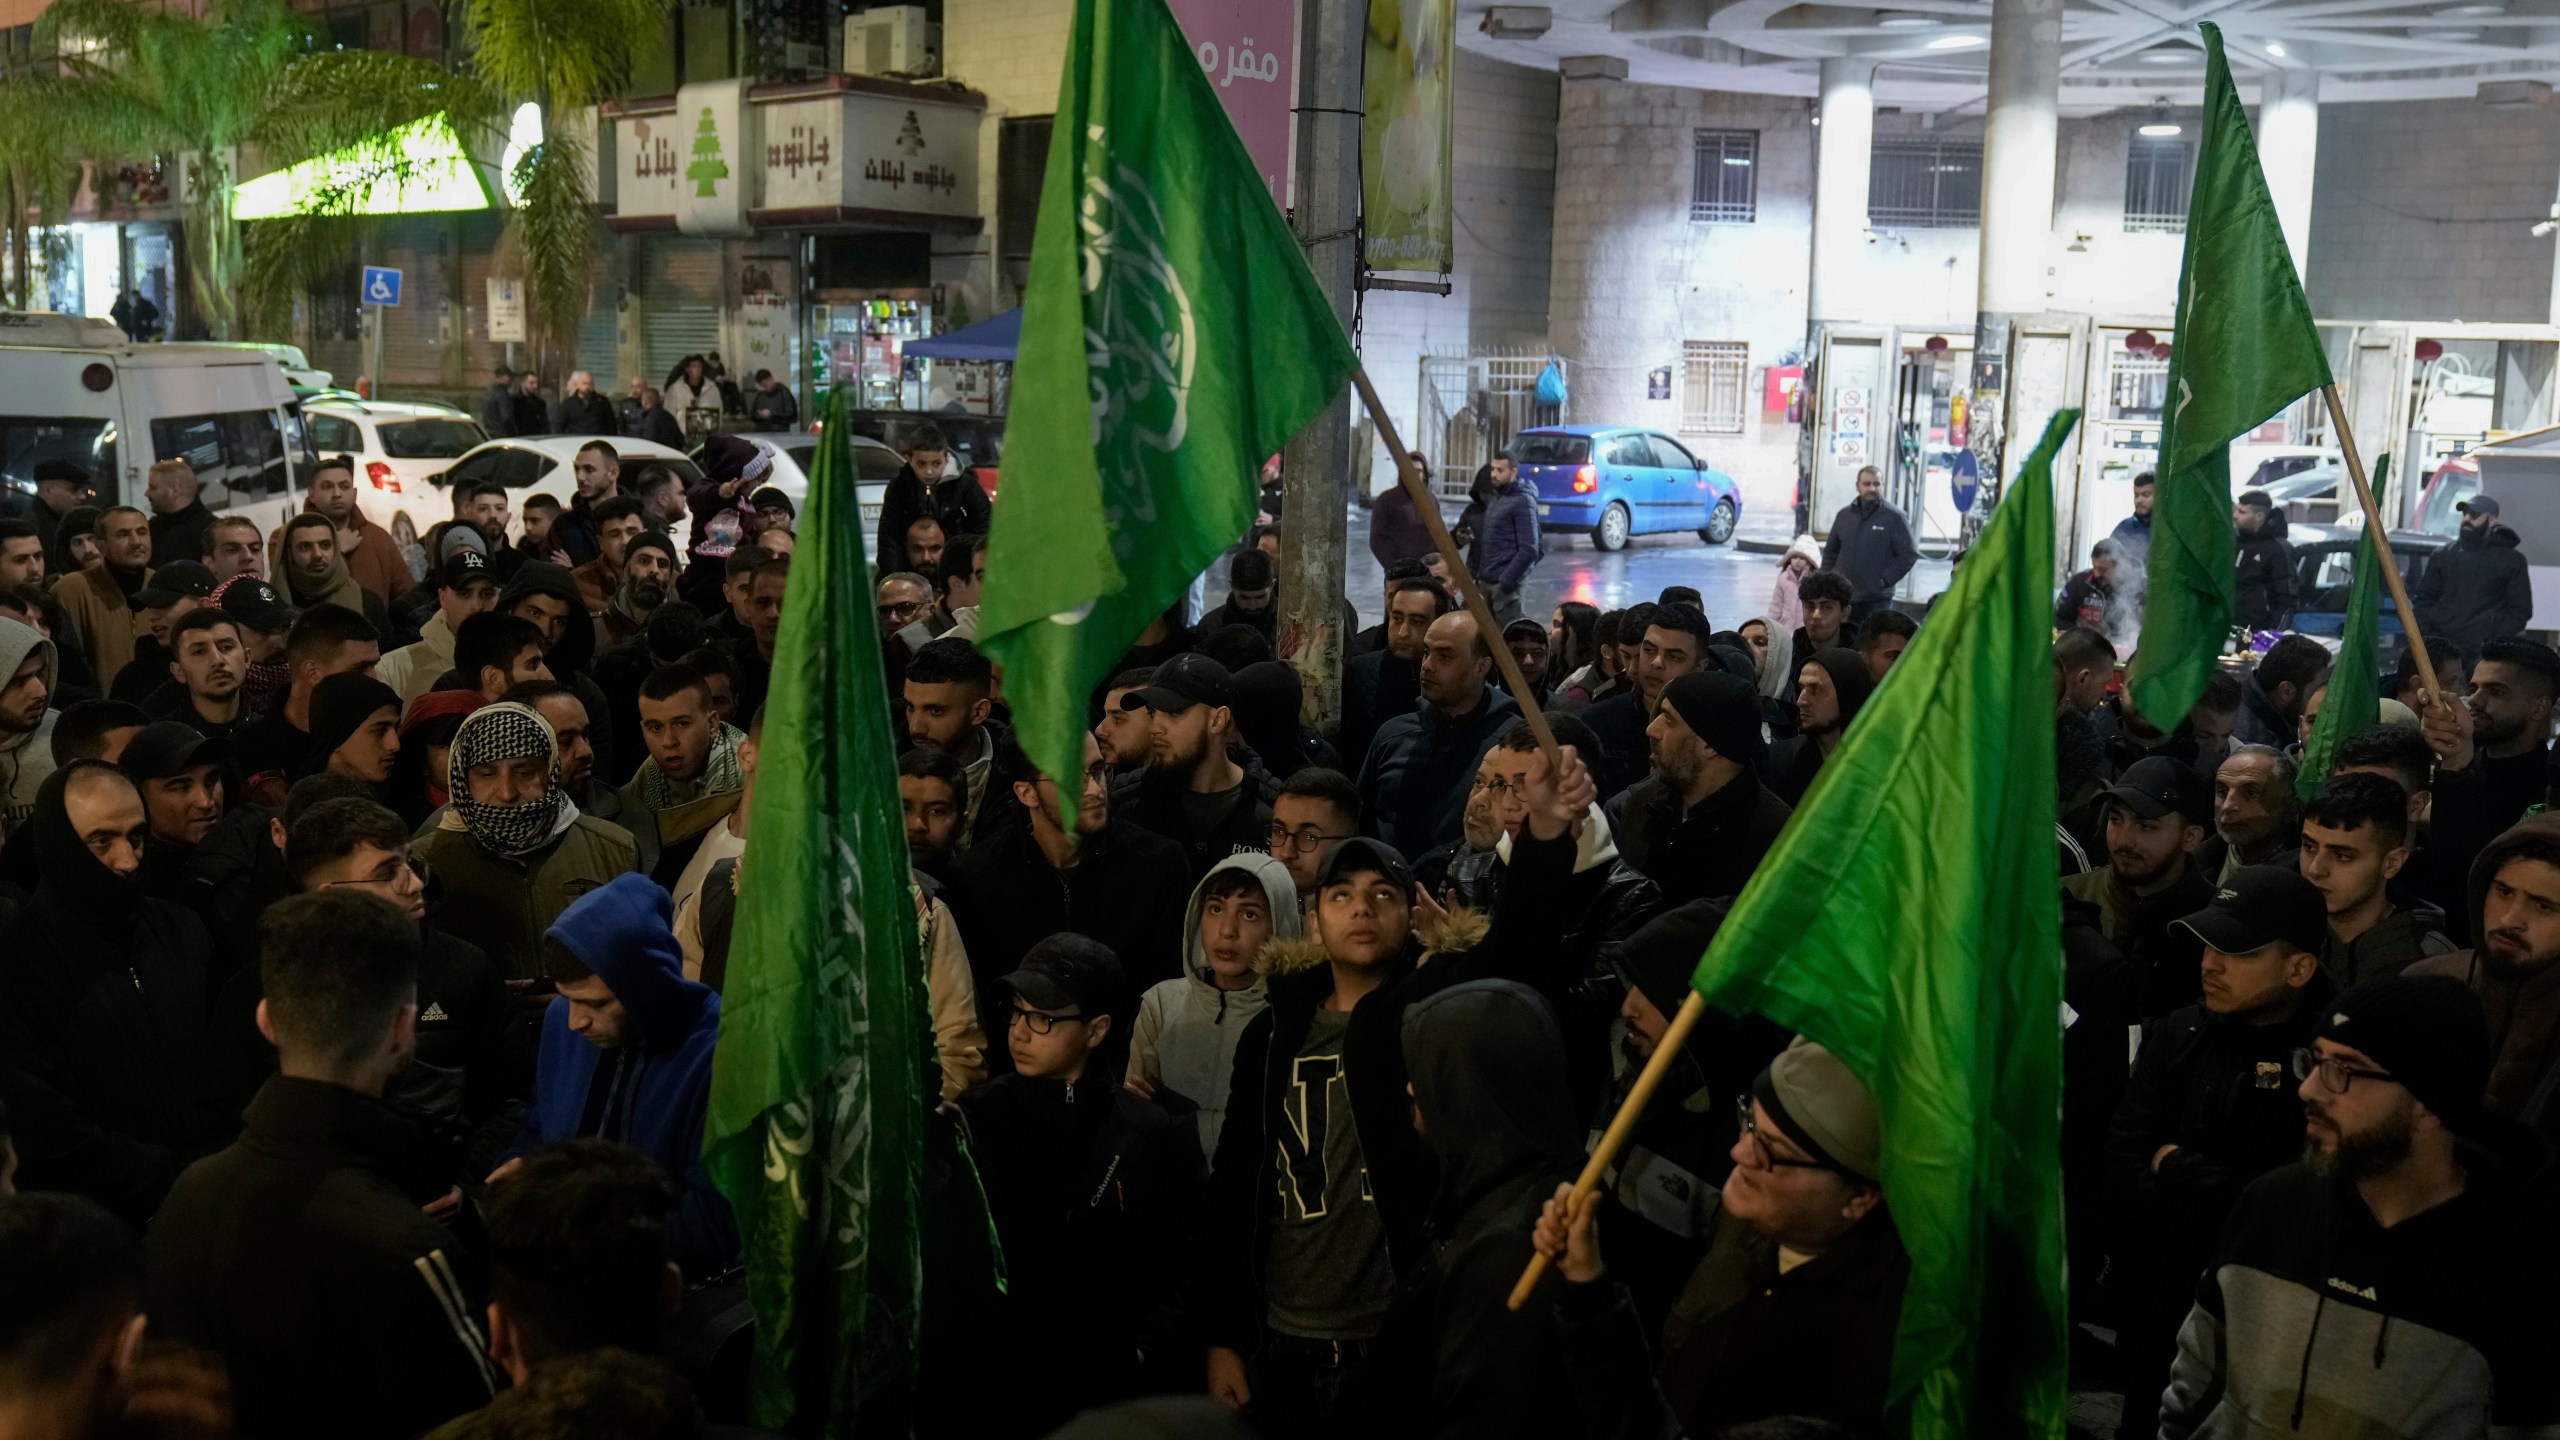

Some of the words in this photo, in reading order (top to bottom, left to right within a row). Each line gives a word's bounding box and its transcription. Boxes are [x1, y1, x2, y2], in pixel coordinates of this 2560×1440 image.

[635, 137, 677, 190] بنان
[865, 158, 905, 190] لبنان
[463, 552, 484, 568] LA
[421, 1013, 448, 1021] adidas
[1277, 1055, 1343, 1219] N
[1091, 1154, 1120, 1207] Columbia
[2328, 1277, 2358, 1294] adidas
